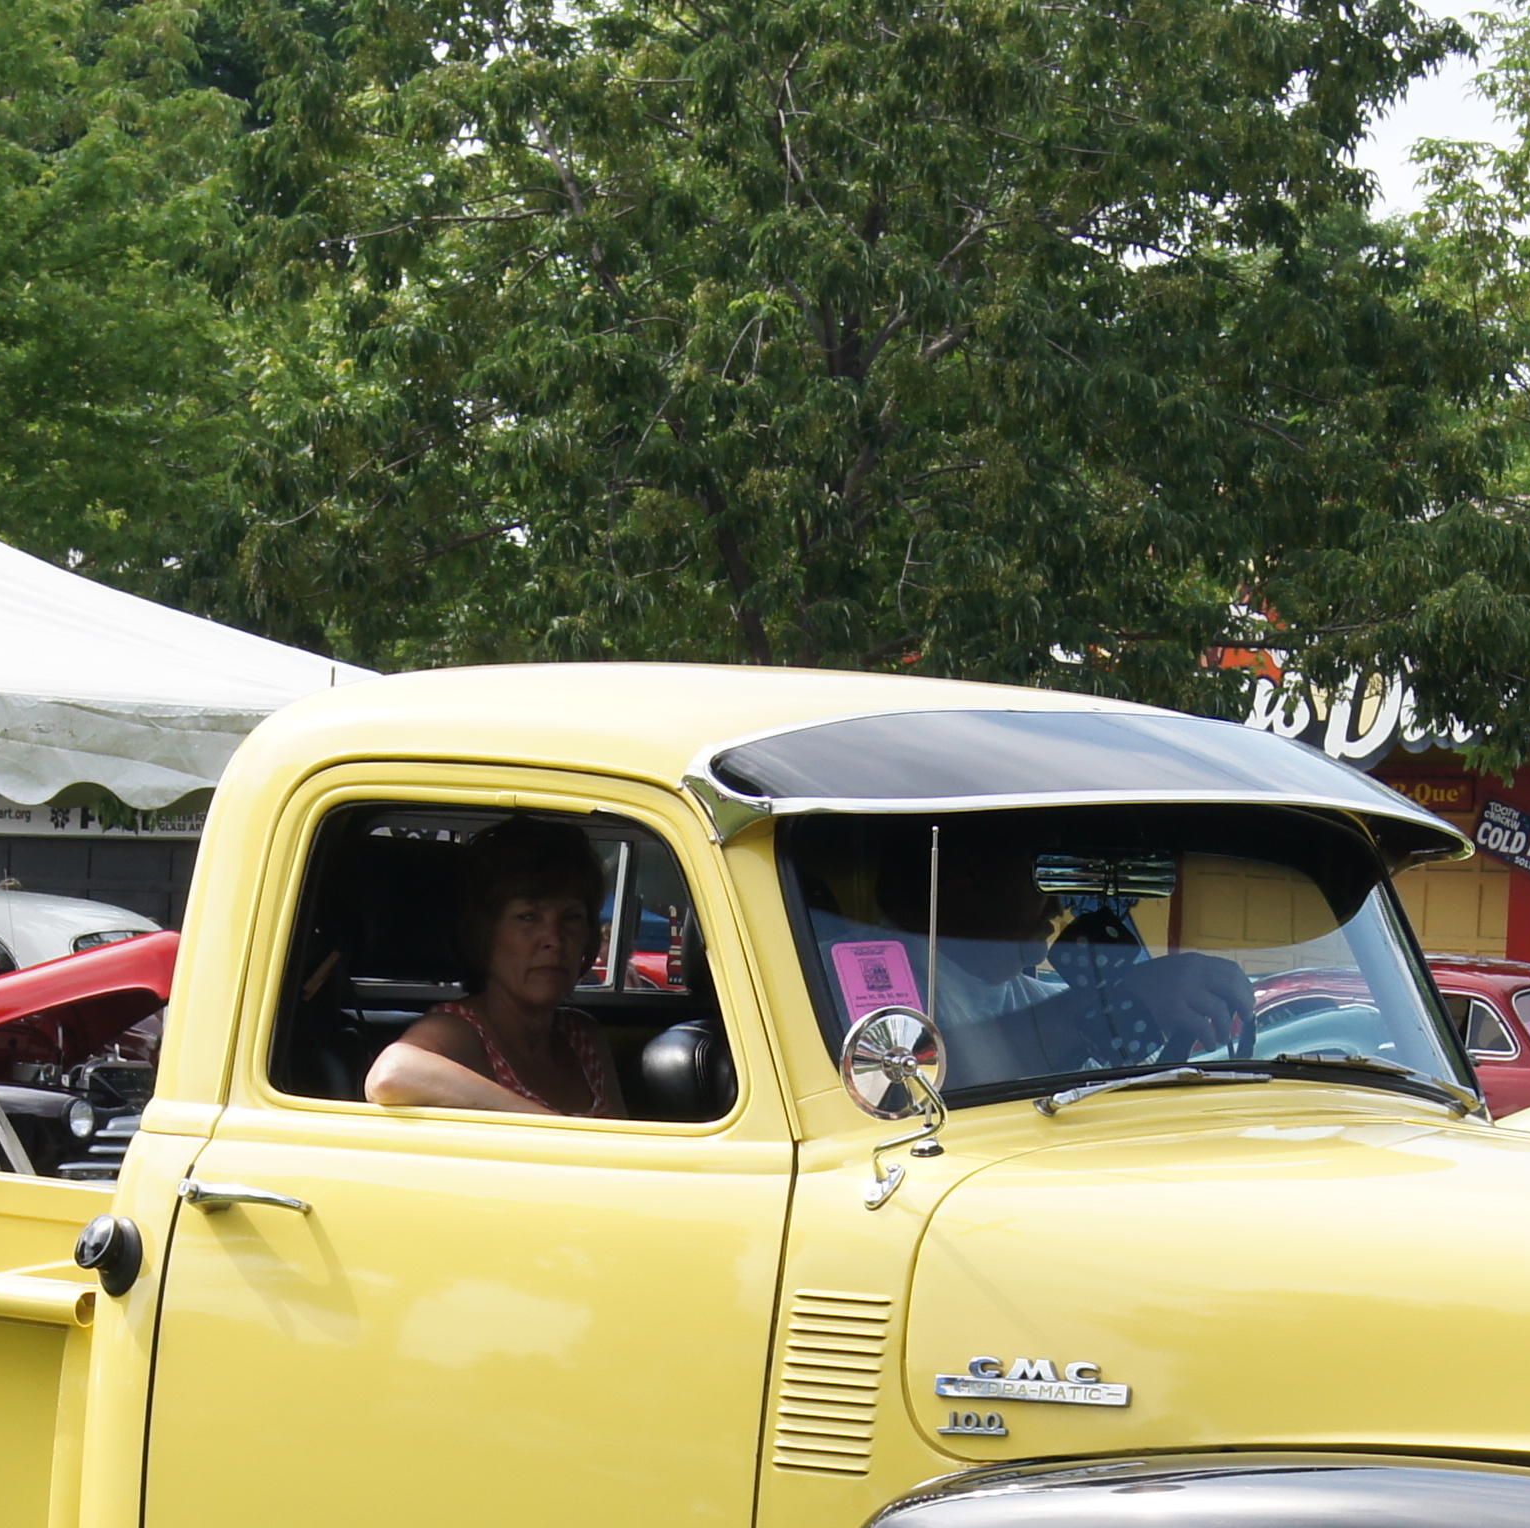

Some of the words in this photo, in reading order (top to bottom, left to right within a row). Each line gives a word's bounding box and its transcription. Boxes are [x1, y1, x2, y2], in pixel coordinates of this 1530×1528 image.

[1489, 802, 1520, 819] TOOTH
[1477, 821, 1526, 854] COLD
[968, 1355, 1101, 1384] GMC
[947, 1411, 1003, 1432] 100
